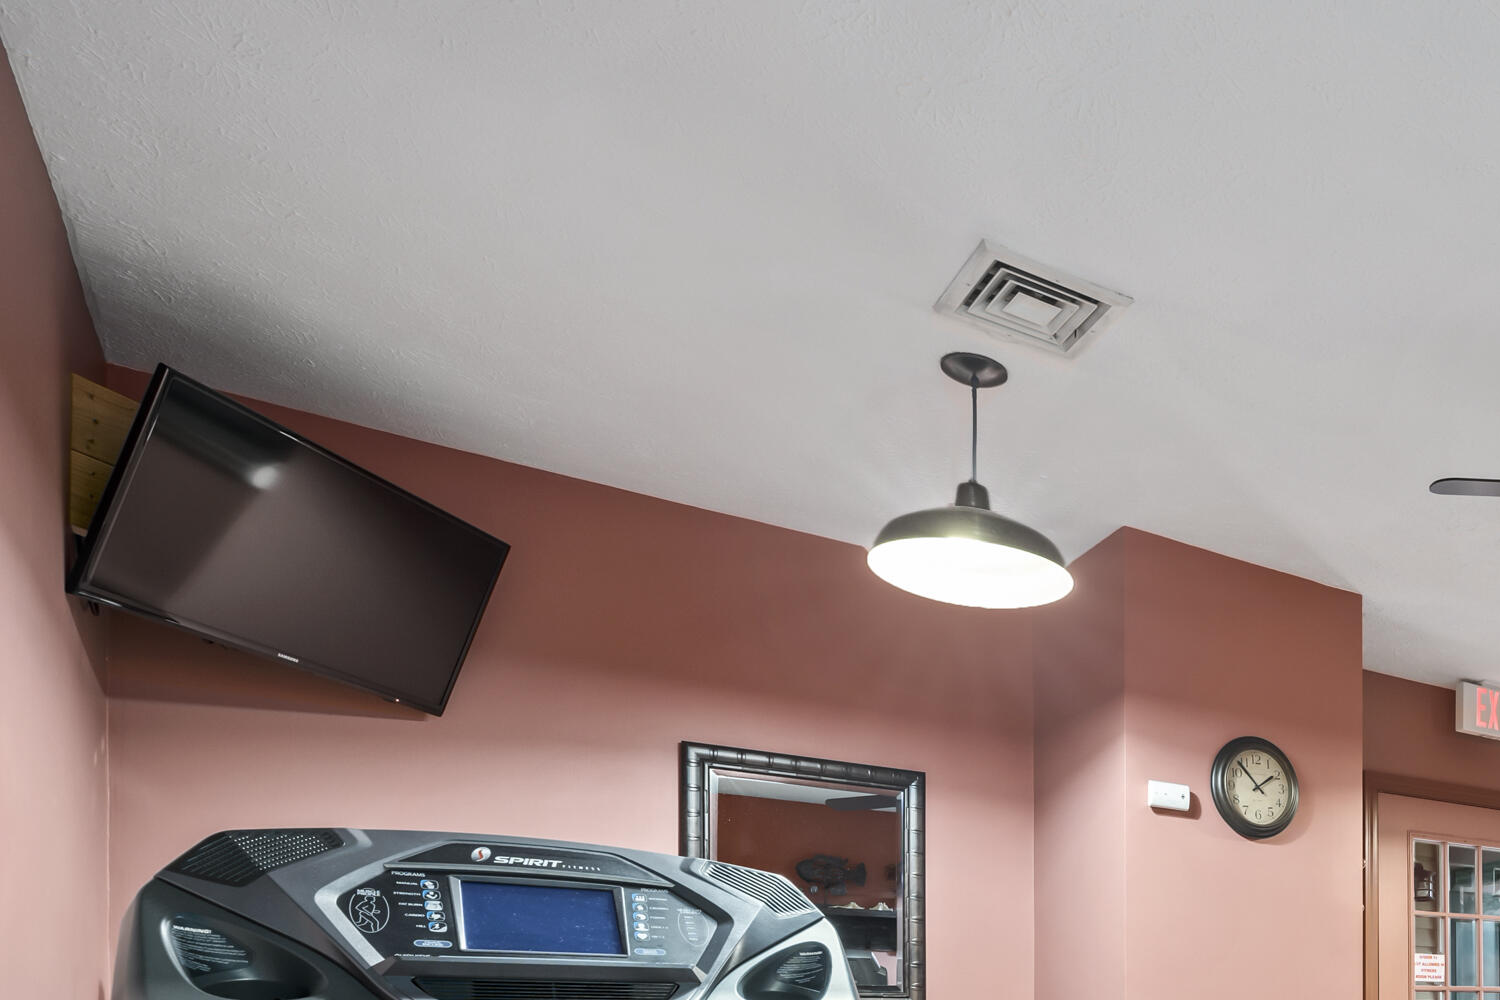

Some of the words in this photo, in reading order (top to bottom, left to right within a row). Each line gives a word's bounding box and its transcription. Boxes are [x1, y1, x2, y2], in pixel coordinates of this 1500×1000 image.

[1251, 754, 1261, 765] 12
[1231, 767, 1243, 778] 10
[1273, 770, 1280, 780] 2
[1228, 780, 1235, 791] 9
[1278, 783, 1284, 794] 3
[1232, 794, 1240, 804] 8
[1275, 798, 1282, 808] 4
[1242, 805, 1249, 815] 7
[1254, 808, 1262, 820] 6
[1267, 806, 1274, 817] 5
[493, 855, 563, 868] SPIRIT
[391, 870, 426, 878] PROGRAMS
[172, 924, 212, 934] WARNING!
